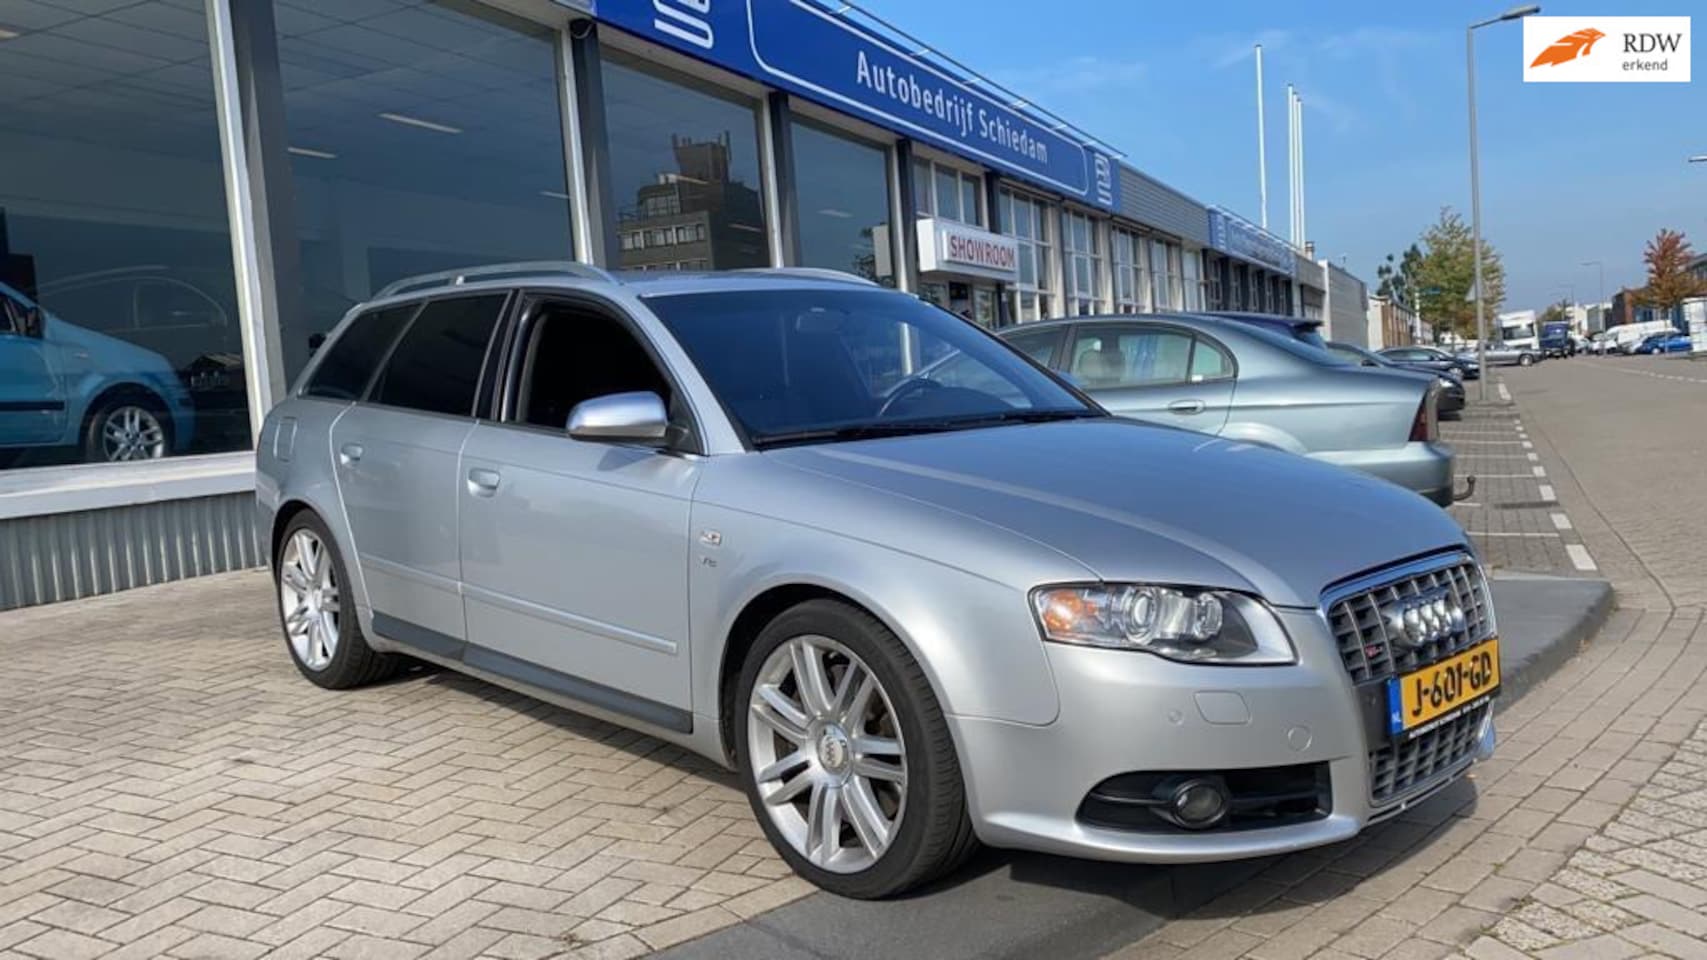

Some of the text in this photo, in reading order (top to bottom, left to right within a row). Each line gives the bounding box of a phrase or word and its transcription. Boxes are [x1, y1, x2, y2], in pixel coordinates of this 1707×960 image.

[857, 50, 1048, 164] Autobedrijf Schiedam
[950, 235, 1016, 268] SHOWROOM
[1411, 651, 1492, 717] J-601-GD
